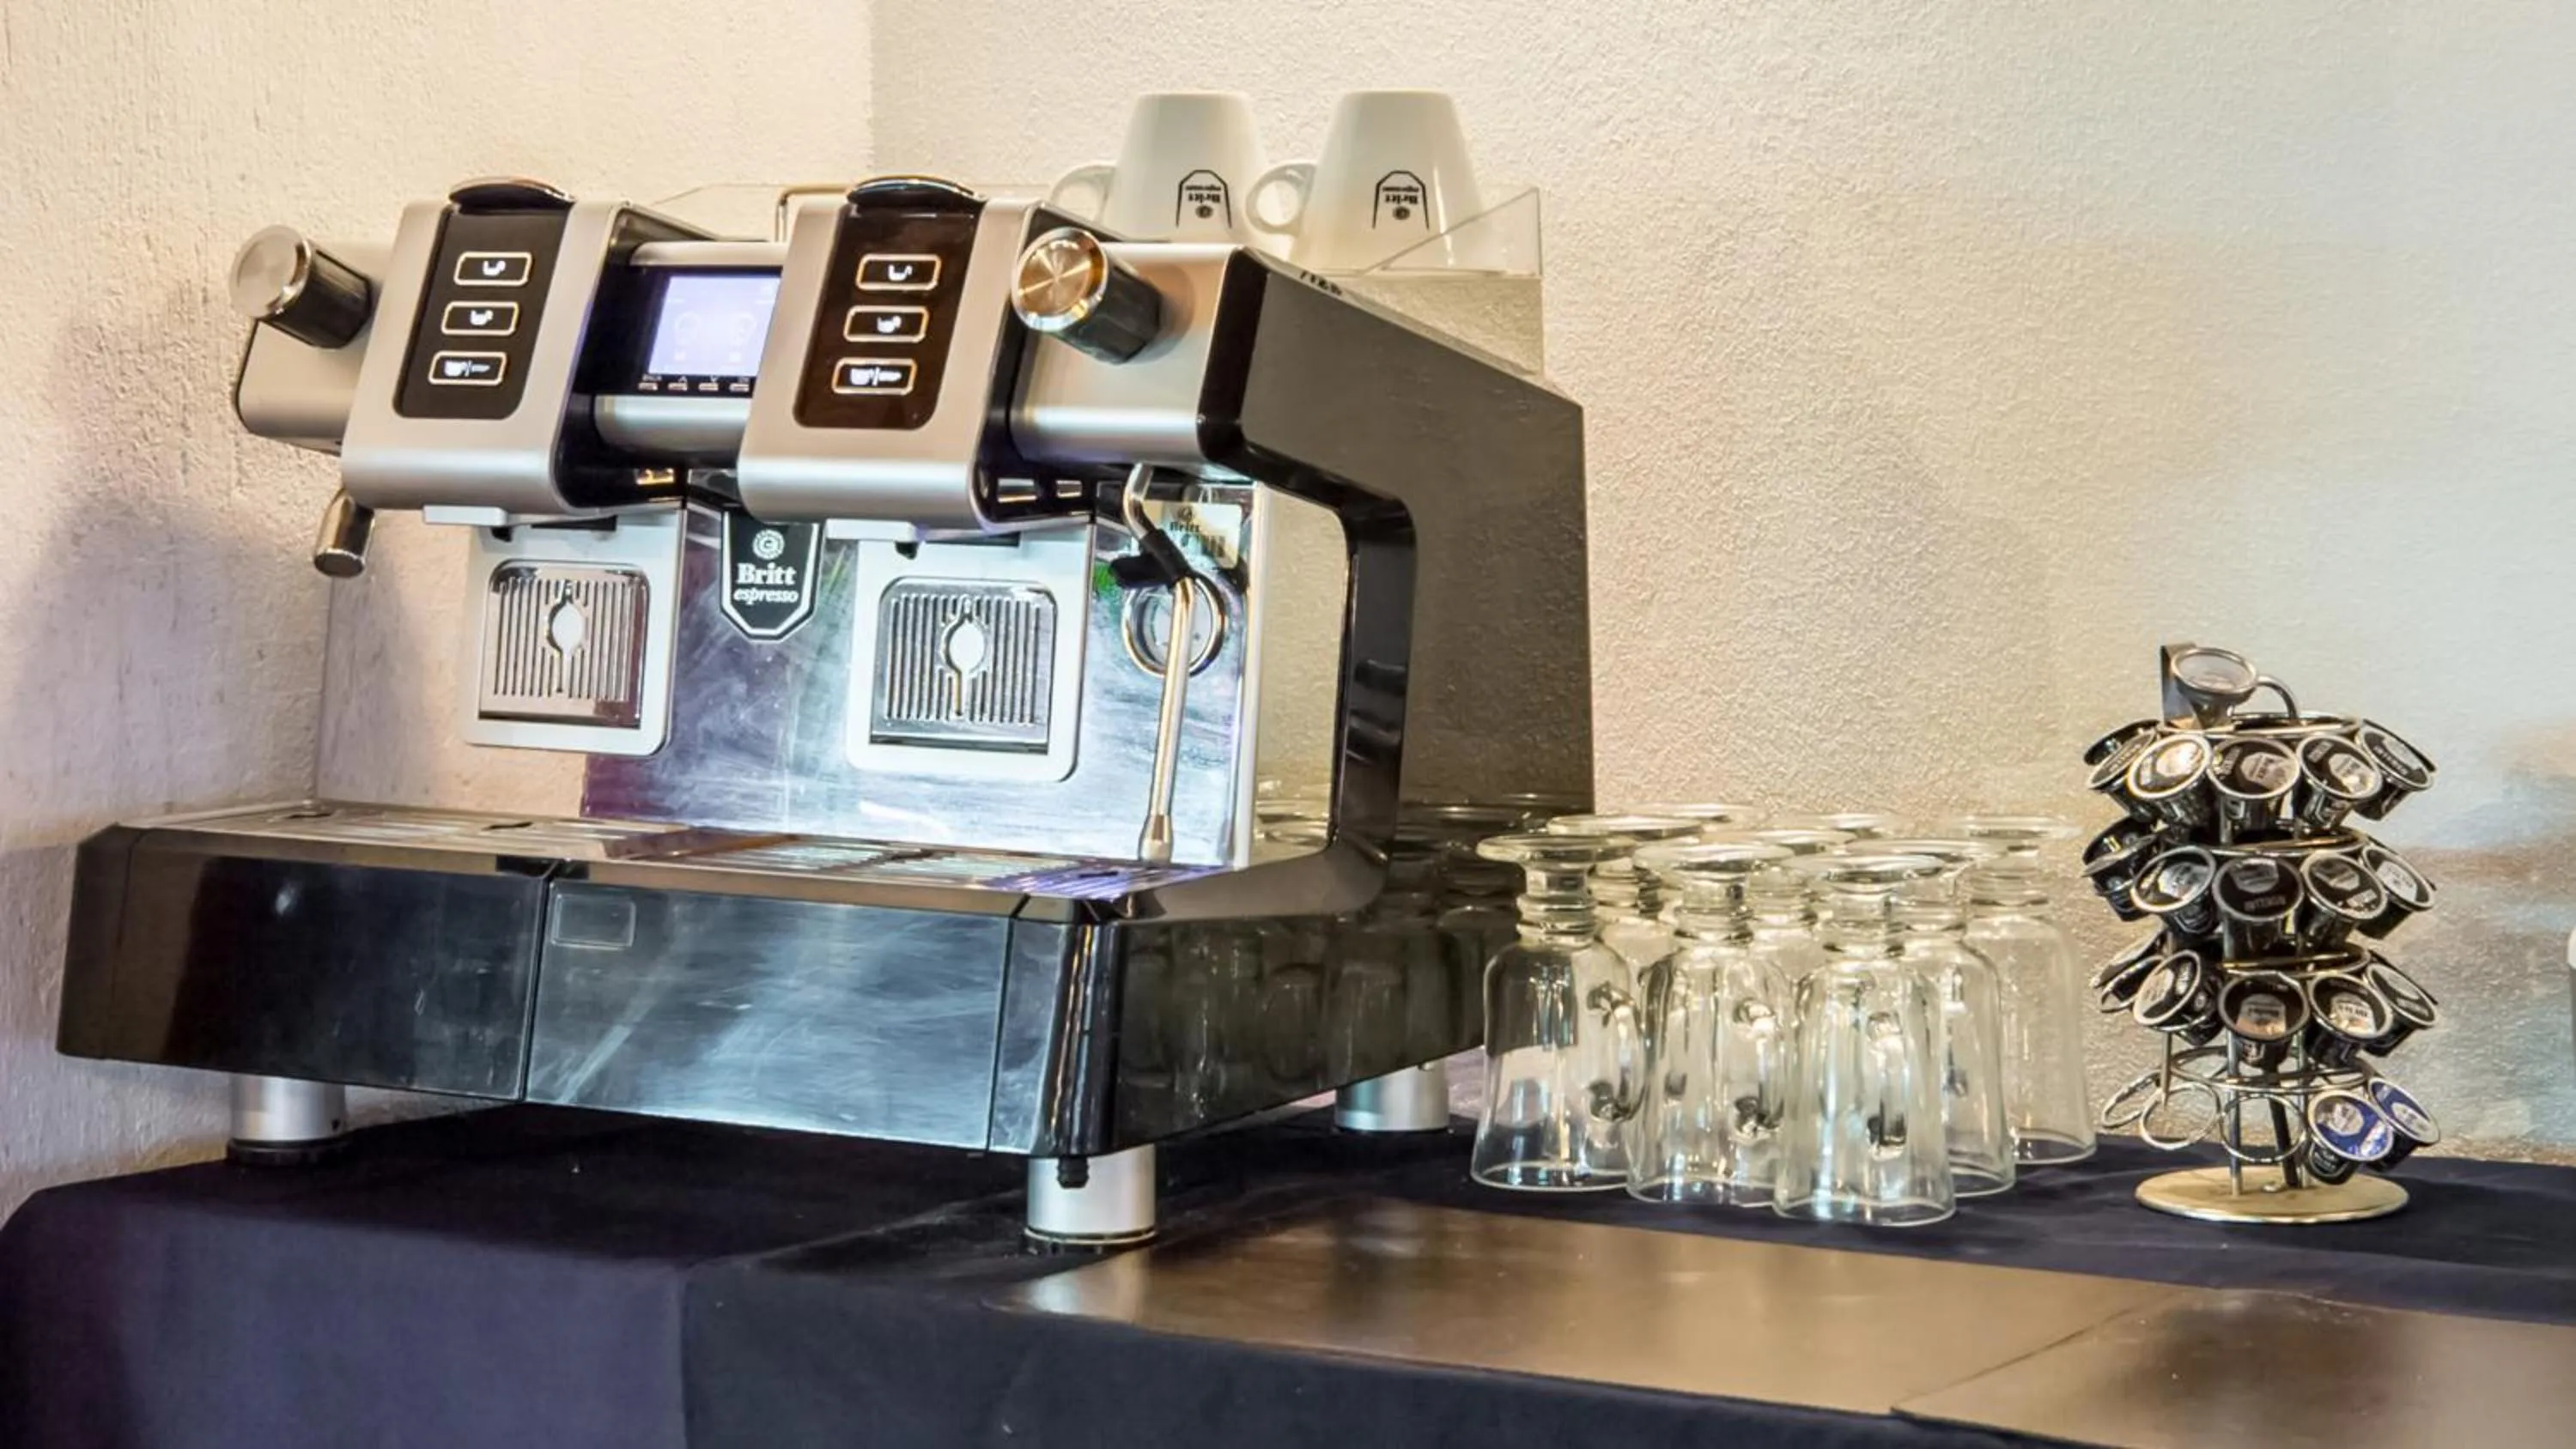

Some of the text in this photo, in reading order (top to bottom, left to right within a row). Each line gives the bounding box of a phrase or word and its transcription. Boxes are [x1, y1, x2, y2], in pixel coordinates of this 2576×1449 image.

[1188, 192, 1221, 203] Britt
[1385, 194, 1418, 205] Britt
[737, 562, 797, 585] Britt
[732, 587, 799, 605] espresso
